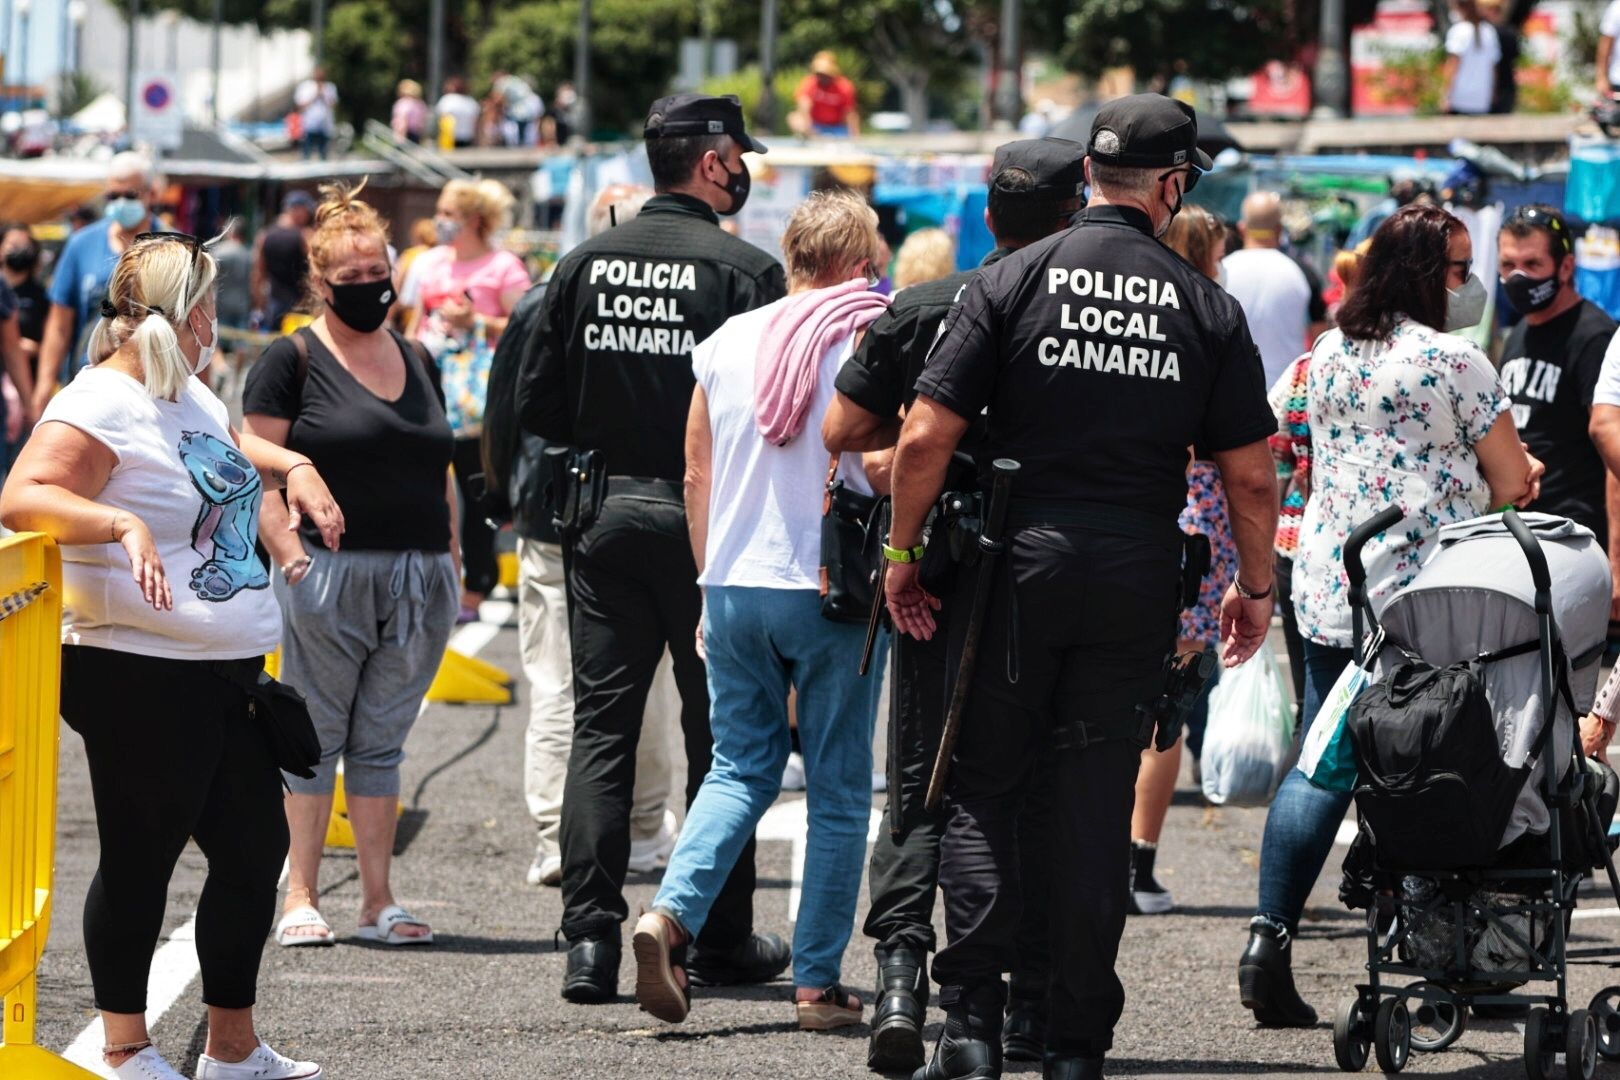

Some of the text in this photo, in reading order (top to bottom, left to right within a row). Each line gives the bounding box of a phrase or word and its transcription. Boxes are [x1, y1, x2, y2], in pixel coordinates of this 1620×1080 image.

[589, 260, 696, 290] POLICIA
[1049, 268, 1180, 310] POLICIA
[597, 293, 684, 322] LOCAL
[1061, 304, 1168, 342] LOCAL
[584, 323, 696, 356] CANARIA
[1037, 337, 1181, 382] CANARIA
